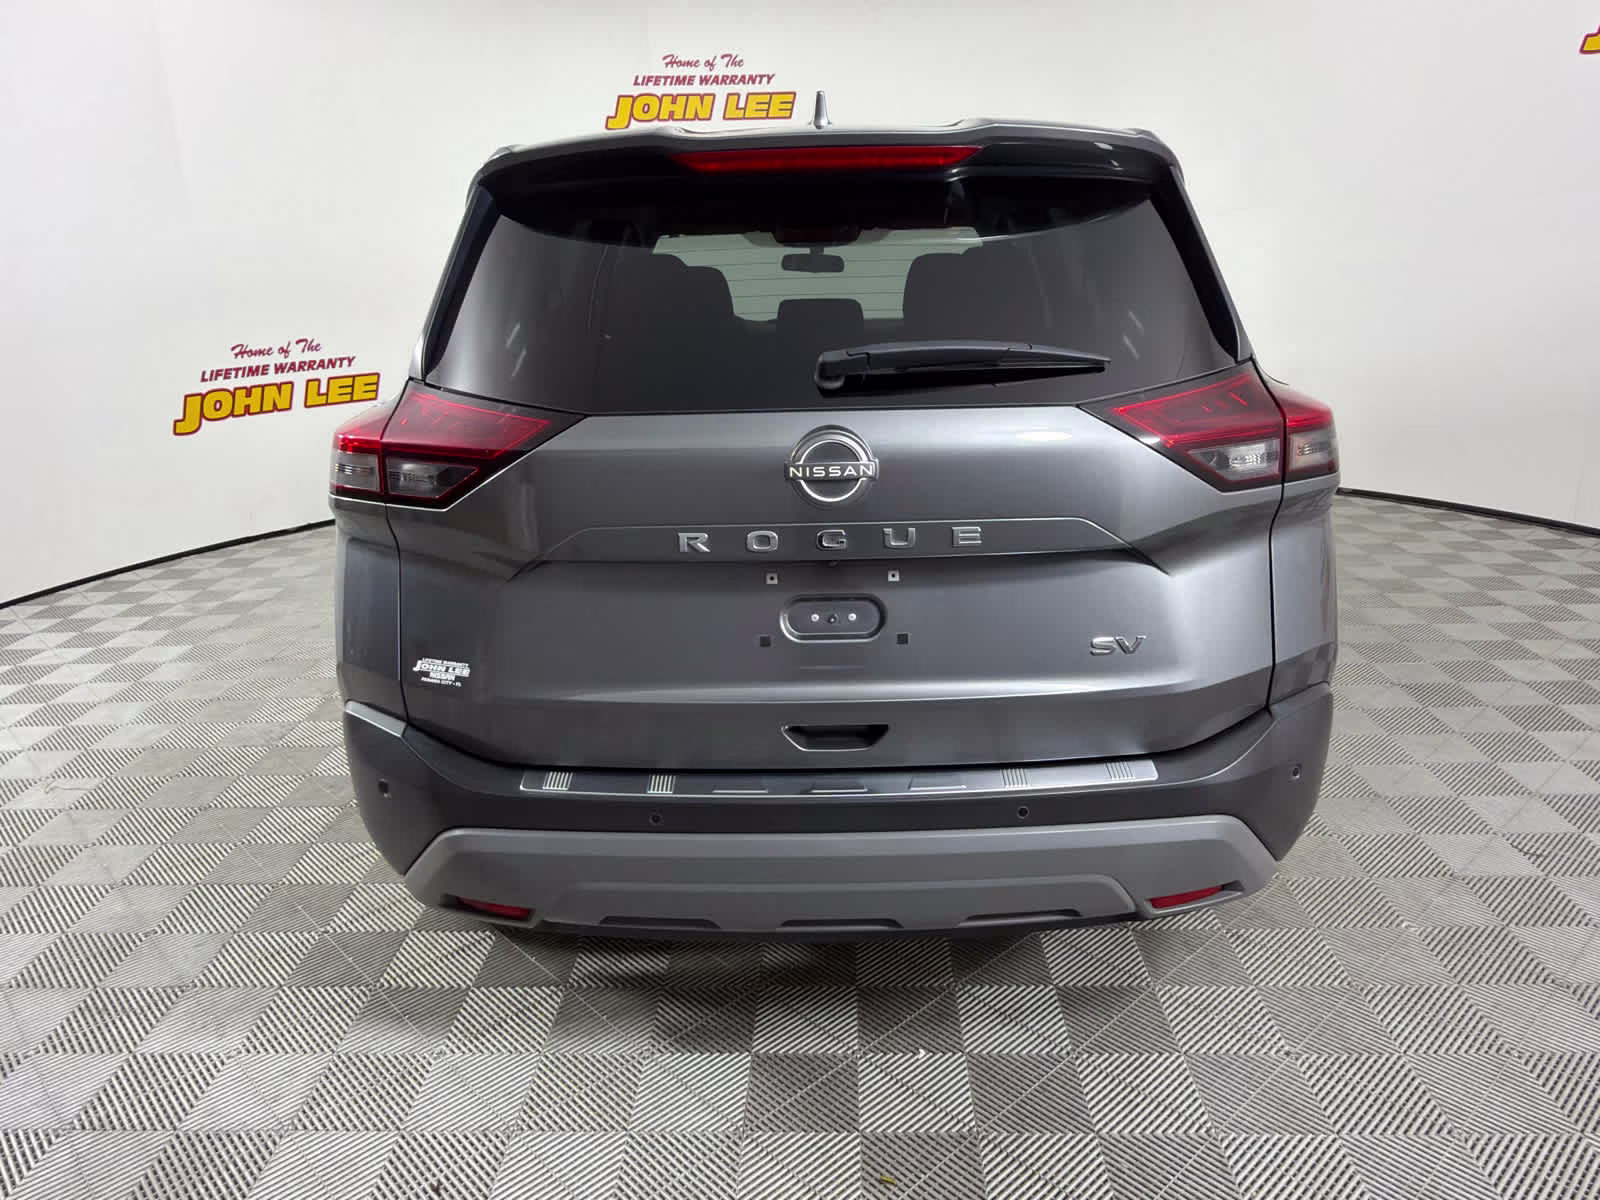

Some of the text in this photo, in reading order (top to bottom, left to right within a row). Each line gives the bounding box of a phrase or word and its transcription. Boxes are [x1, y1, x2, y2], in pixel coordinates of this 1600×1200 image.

[662, 53, 744, 71] Home of The
[633, 74, 775, 86] LIFETIME WARRANTY
[605, 92, 796, 130] JOHN LEE
[231, 338, 321, 359] Home of The
[200, 356, 356, 382] LIFETIME WARRANTY
[173, 372, 380, 435] JOHN LEE
[789, 464, 874, 477] NISSAN
[678, 526, 982, 552] ROGUE
[1090, 635, 1147, 656] SV
[412, 660, 447, 672] JOHN
